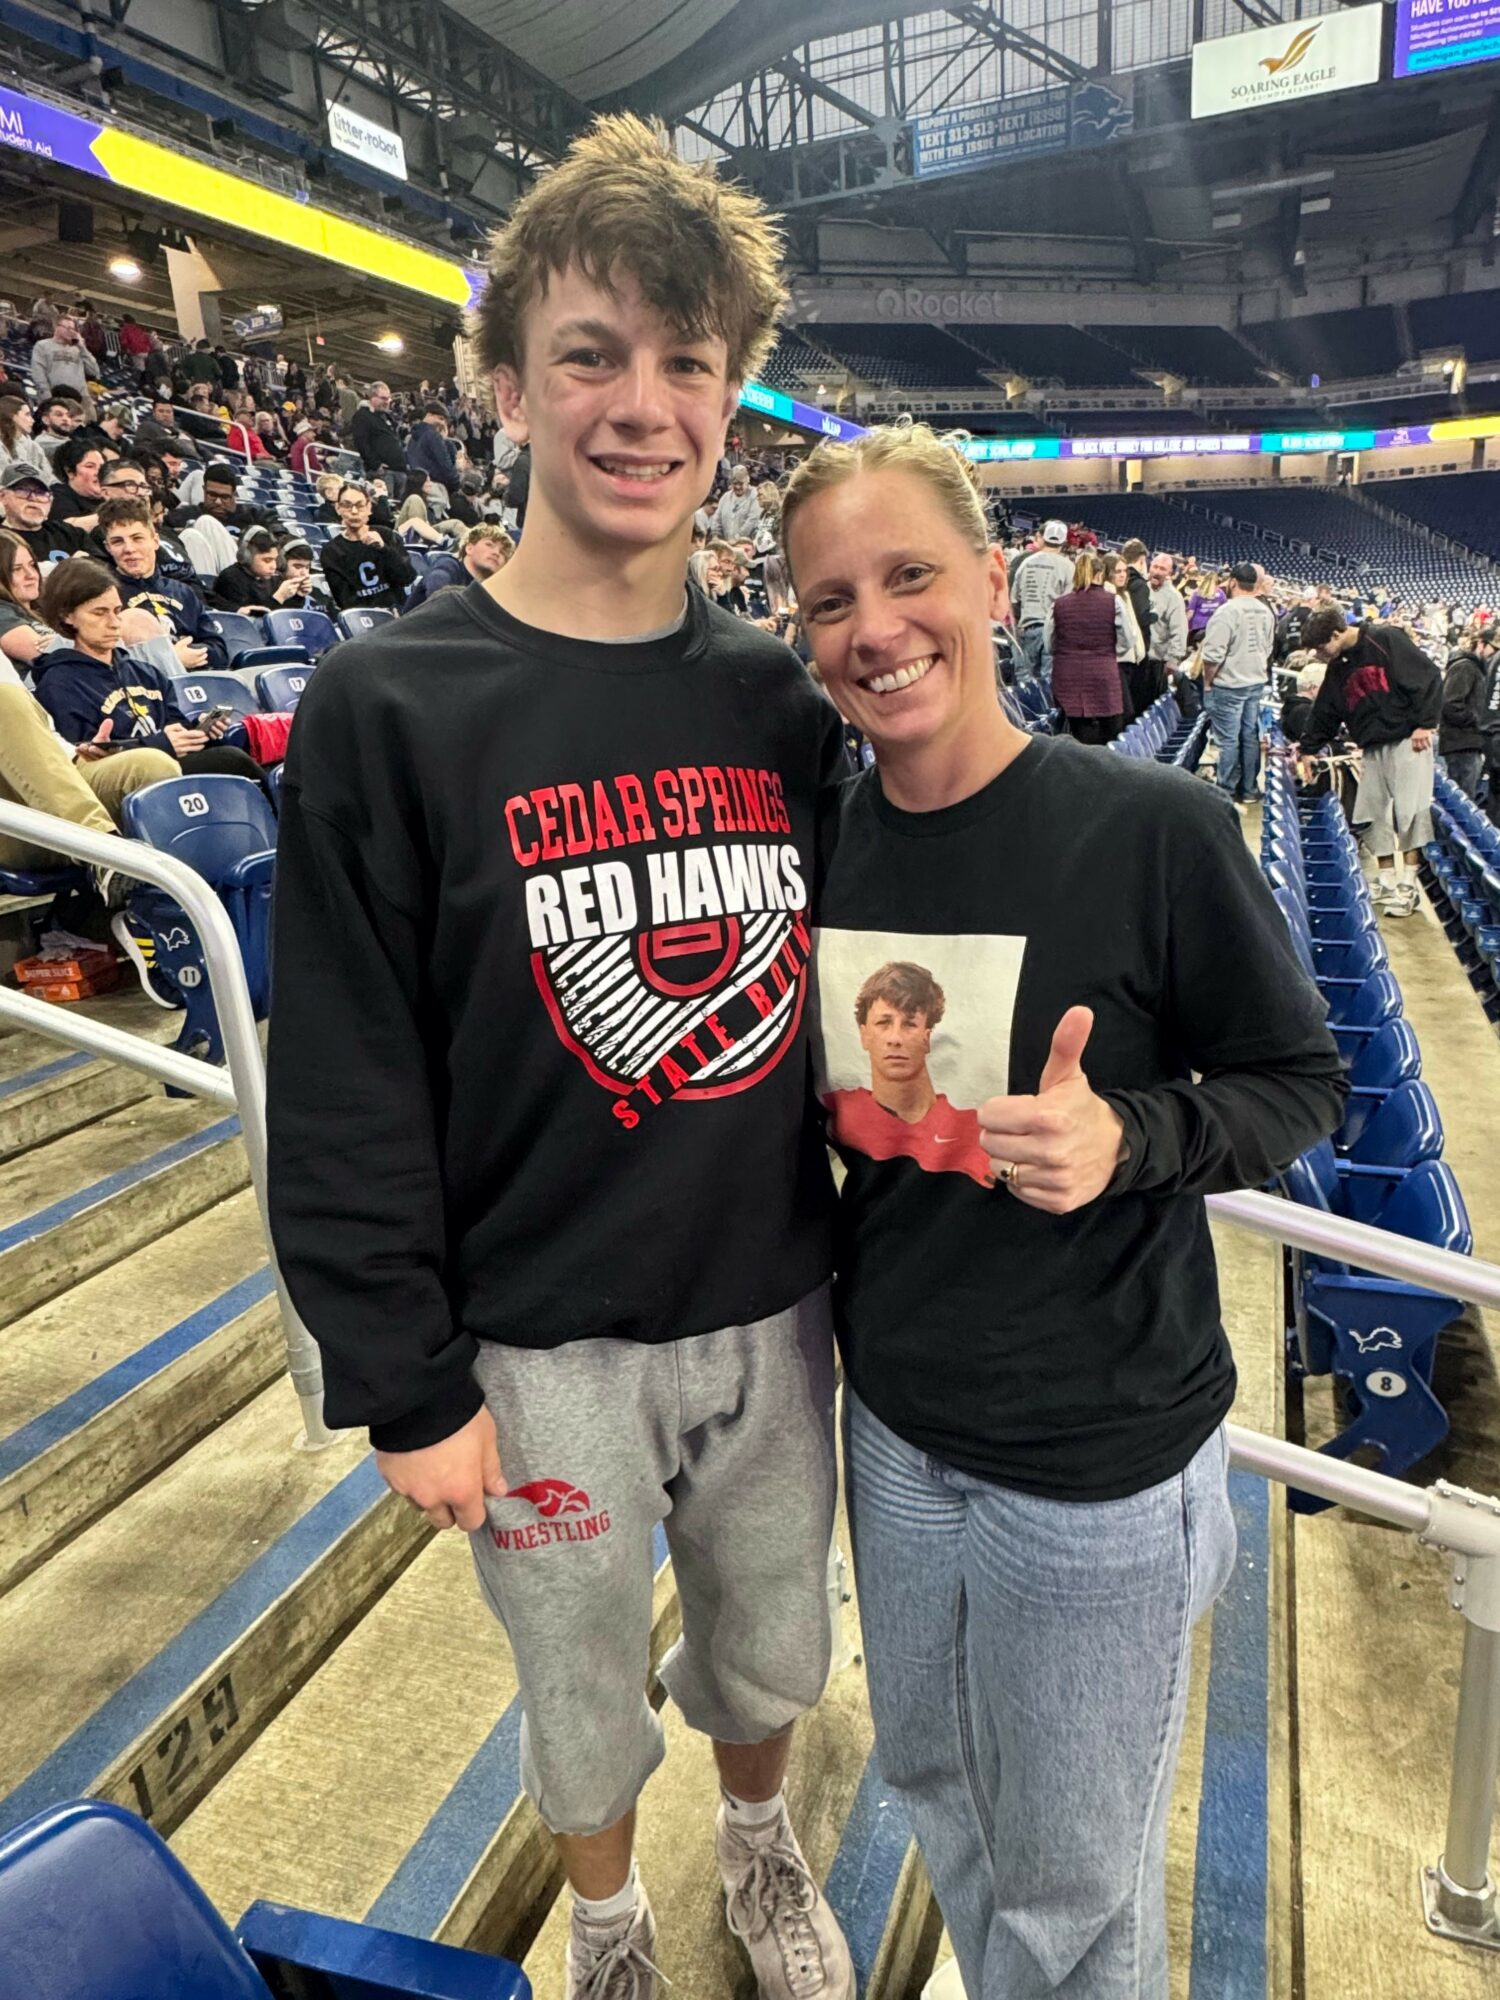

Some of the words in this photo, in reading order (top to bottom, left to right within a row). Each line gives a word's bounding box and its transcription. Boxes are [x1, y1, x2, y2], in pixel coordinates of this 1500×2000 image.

[1411, 0, 1444, 18] HAVE
[1231, 76, 1290, 99] SOARING
[1293, 66, 1336, 87] EAGLE
[951, 112, 958, 124] A
[918, 131, 946, 149] TEXT
[919, 147, 945, 163] WITH
[947, 144, 964, 158] THE
[966, 138, 995, 155] ISSUE
[997, 132, 1016, 147] AND
[1018, 123, 1066, 142] LOCATION
[904, 288, 1003, 317] Rocket
[359, 561, 379, 587] C
[187, 689, 203, 701] 18
[183, 797, 204, 812] 20
[504, 774, 656, 867] CEDAR
[653, 766, 791, 838] SPRINGS
[525, 860, 639, 948] RED
[646, 844, 807, 927] HAWKS
[183, 970, 196, 983] 11
[612, 1015, 736, 1130] STATE
[744, 911, 812, 1022] BOUN
[1380, 1376, 1392, 1391] 8
[489, 1509, 611, 1550] WRESTLING
[128, 1672, 239, 1821] 129
